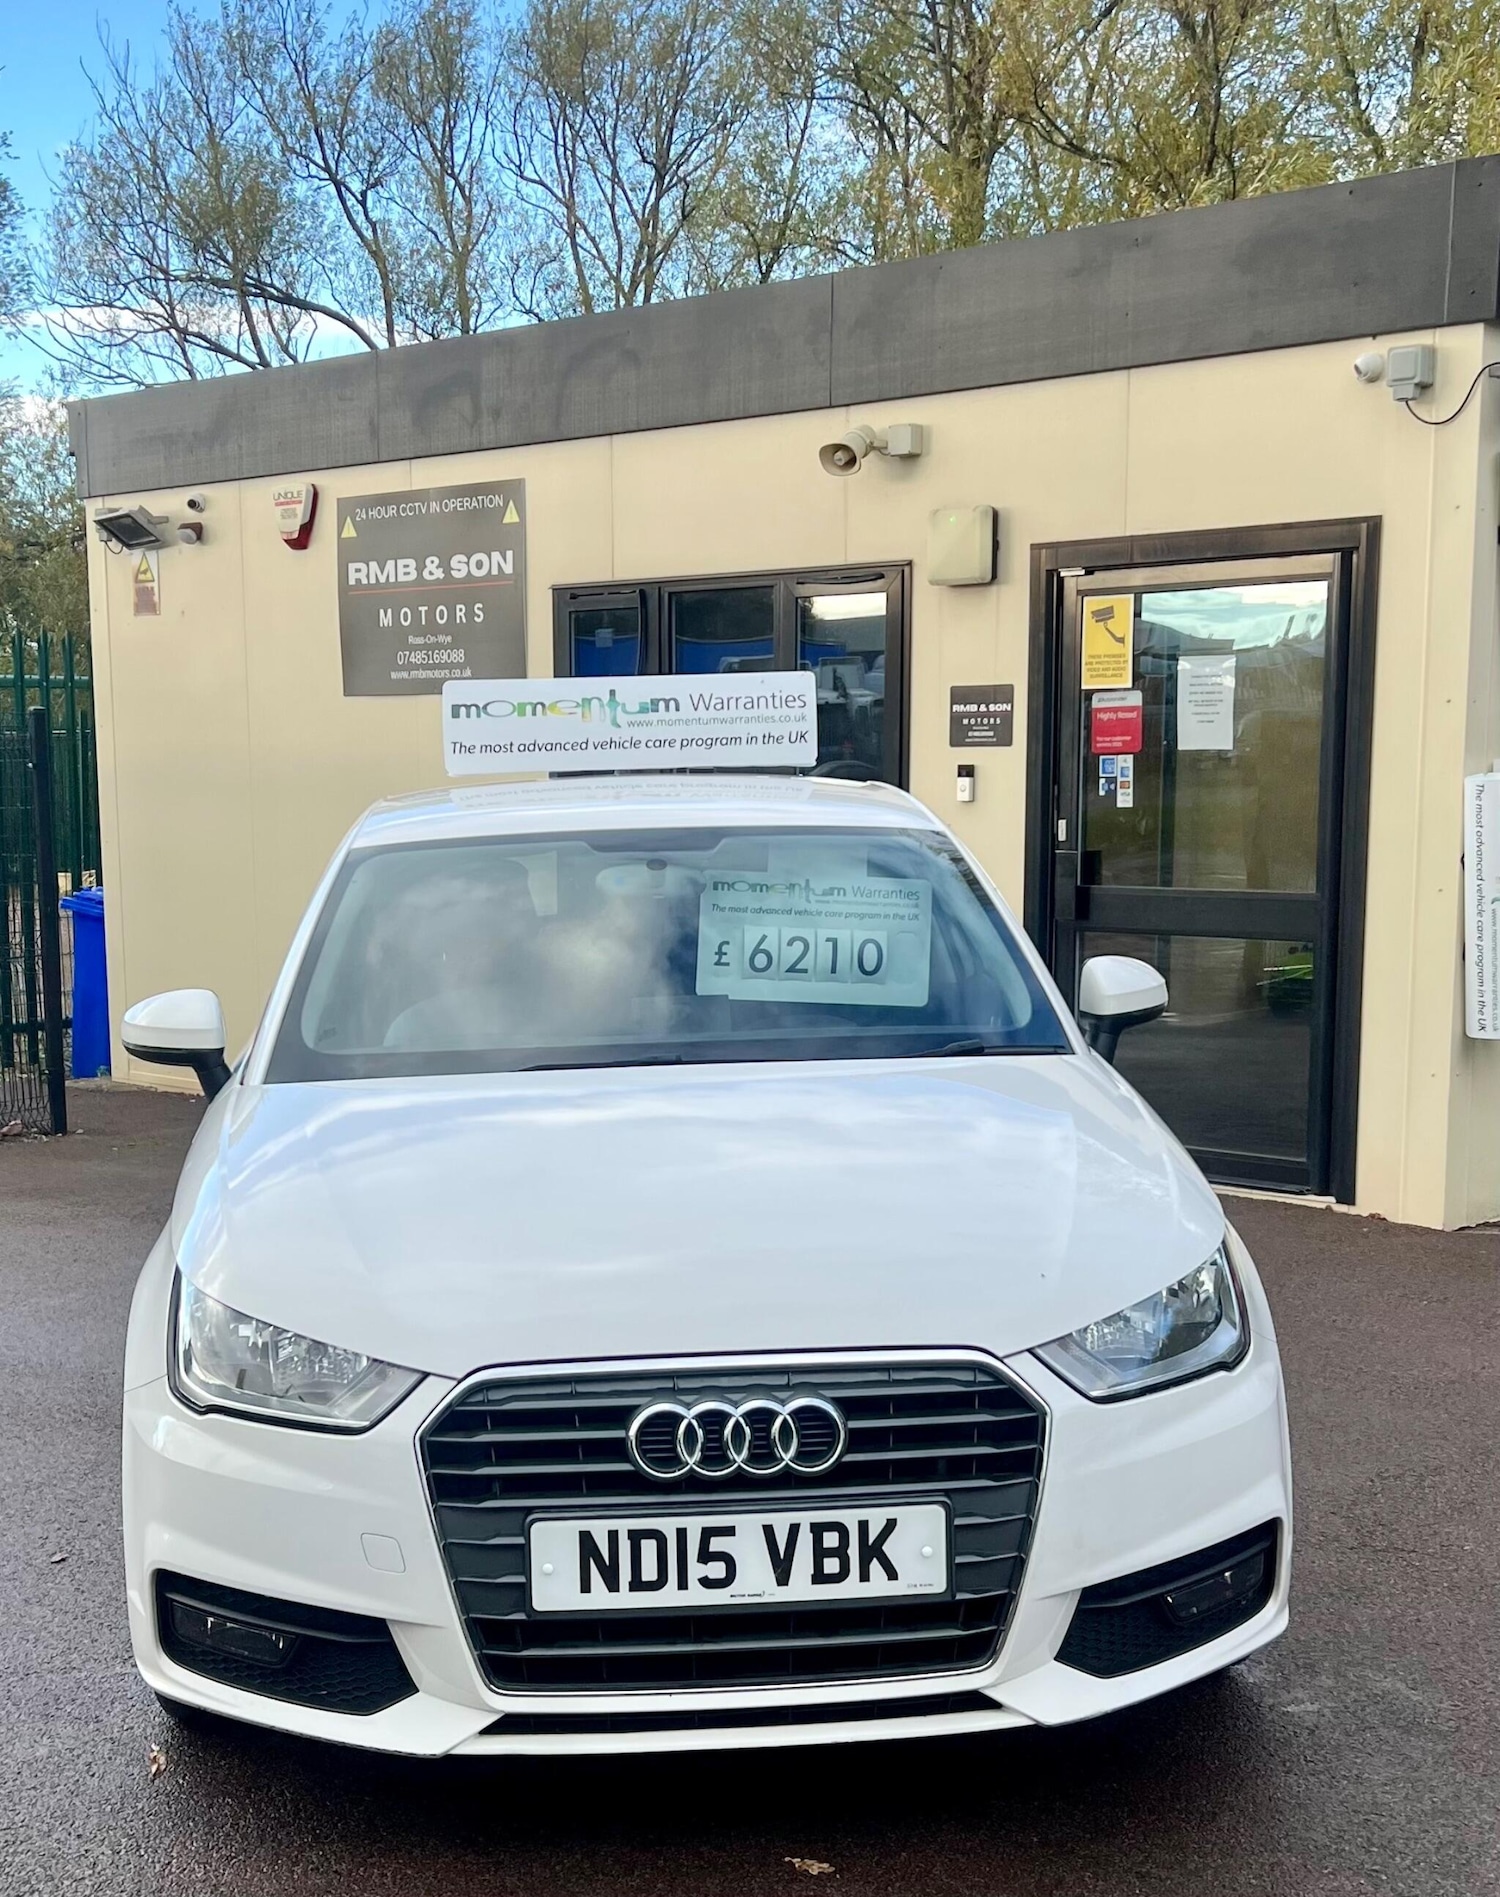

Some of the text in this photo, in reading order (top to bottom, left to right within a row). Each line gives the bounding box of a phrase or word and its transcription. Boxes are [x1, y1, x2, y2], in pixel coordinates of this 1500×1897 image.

[355, 494, 504, 521] 24 HOUR CCTV IN OPERATION
[348, 550, 514, 586] RMB & SON
[379, 603, 484, 627] MOTORS
[408, 634, 452, 645] Ross-On-Wye
[397, 648, 465, 665] 07485169088
[390, 666, 472, 680] www.rmbmotors.co.uk
[451, 689, 807, 729] momentum Warranties
[952, 703, 1012, 712] RMB & SON
[626, 713, 808, 728] www.momentumwarranties.co.uk
[451, 730, 809, 755] The most advanced vehicle care program in the UK
[1475, 784, 1485, 802] The
[1476, 804, 1484, 828] most
[1476, 830, 1485, 881] advanced
[712, 878, 920, 904] momentum Warranties
[1476, 884, 1486, 918] vehicle
[711, 904, 920, 921] The most advanced vehicle care program in the UK
[713, 934, 884, 976] £ 6210
[1475, 944, 1484, 987] program
[1478, 989, 1486, 998] in
[1477, 1000, 1486, 1016] the
[1478, 1018, 1488, 1032] UK
[579, 1518, 898, 1594] ND15 VBK
